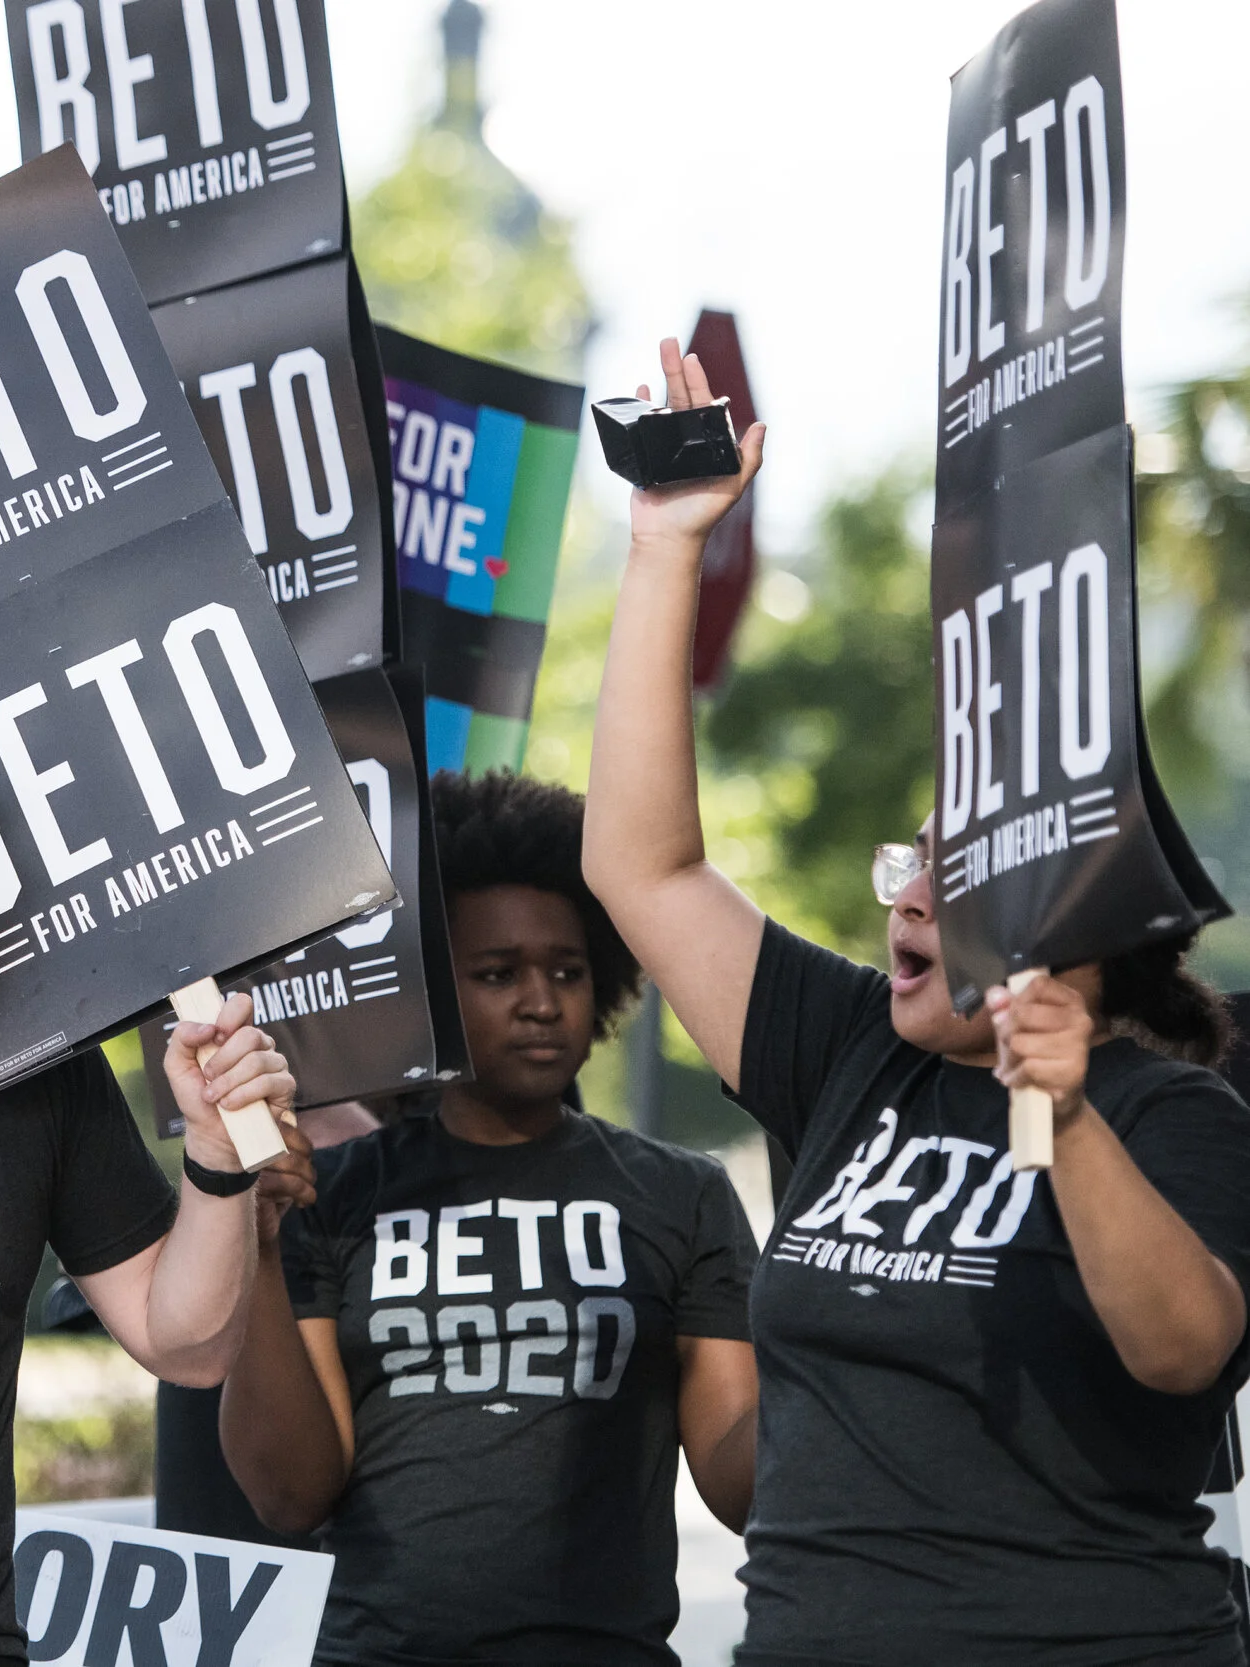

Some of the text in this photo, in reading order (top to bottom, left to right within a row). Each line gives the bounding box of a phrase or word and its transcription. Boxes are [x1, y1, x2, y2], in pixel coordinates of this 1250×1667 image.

[26, 0, 312, 178] BETO
[98, 147, 265, 226] FOR AMERICA
[945, 75, 1111, 389] BETO
[966, 336, 1066, 434] FOR AMERICA
[179, 346, 354, 556] TO
[941, 541, 1112, 841] BETO
[31, 892, 98, 954] FOR
[104, 819, 255, 918] AMERICA
[965, 802, 1070, 891] FOR AMERICA
[252, 967, 349, 1026] AMERICA
[4, 1060, 14, 1069] FOR
[20, 1051, 32, 1061] BETO
[32, 1046, 42, 1055] FOR
[42, 1036, 63, 1050] AMERICA
[792, 1107, 1039, 1249] BETO
[370, 1197, 628, 1301] BETO
[803, 1237, 945, 1282] FOR AMERICA
[369, 1297, 636, 1399] 2020
